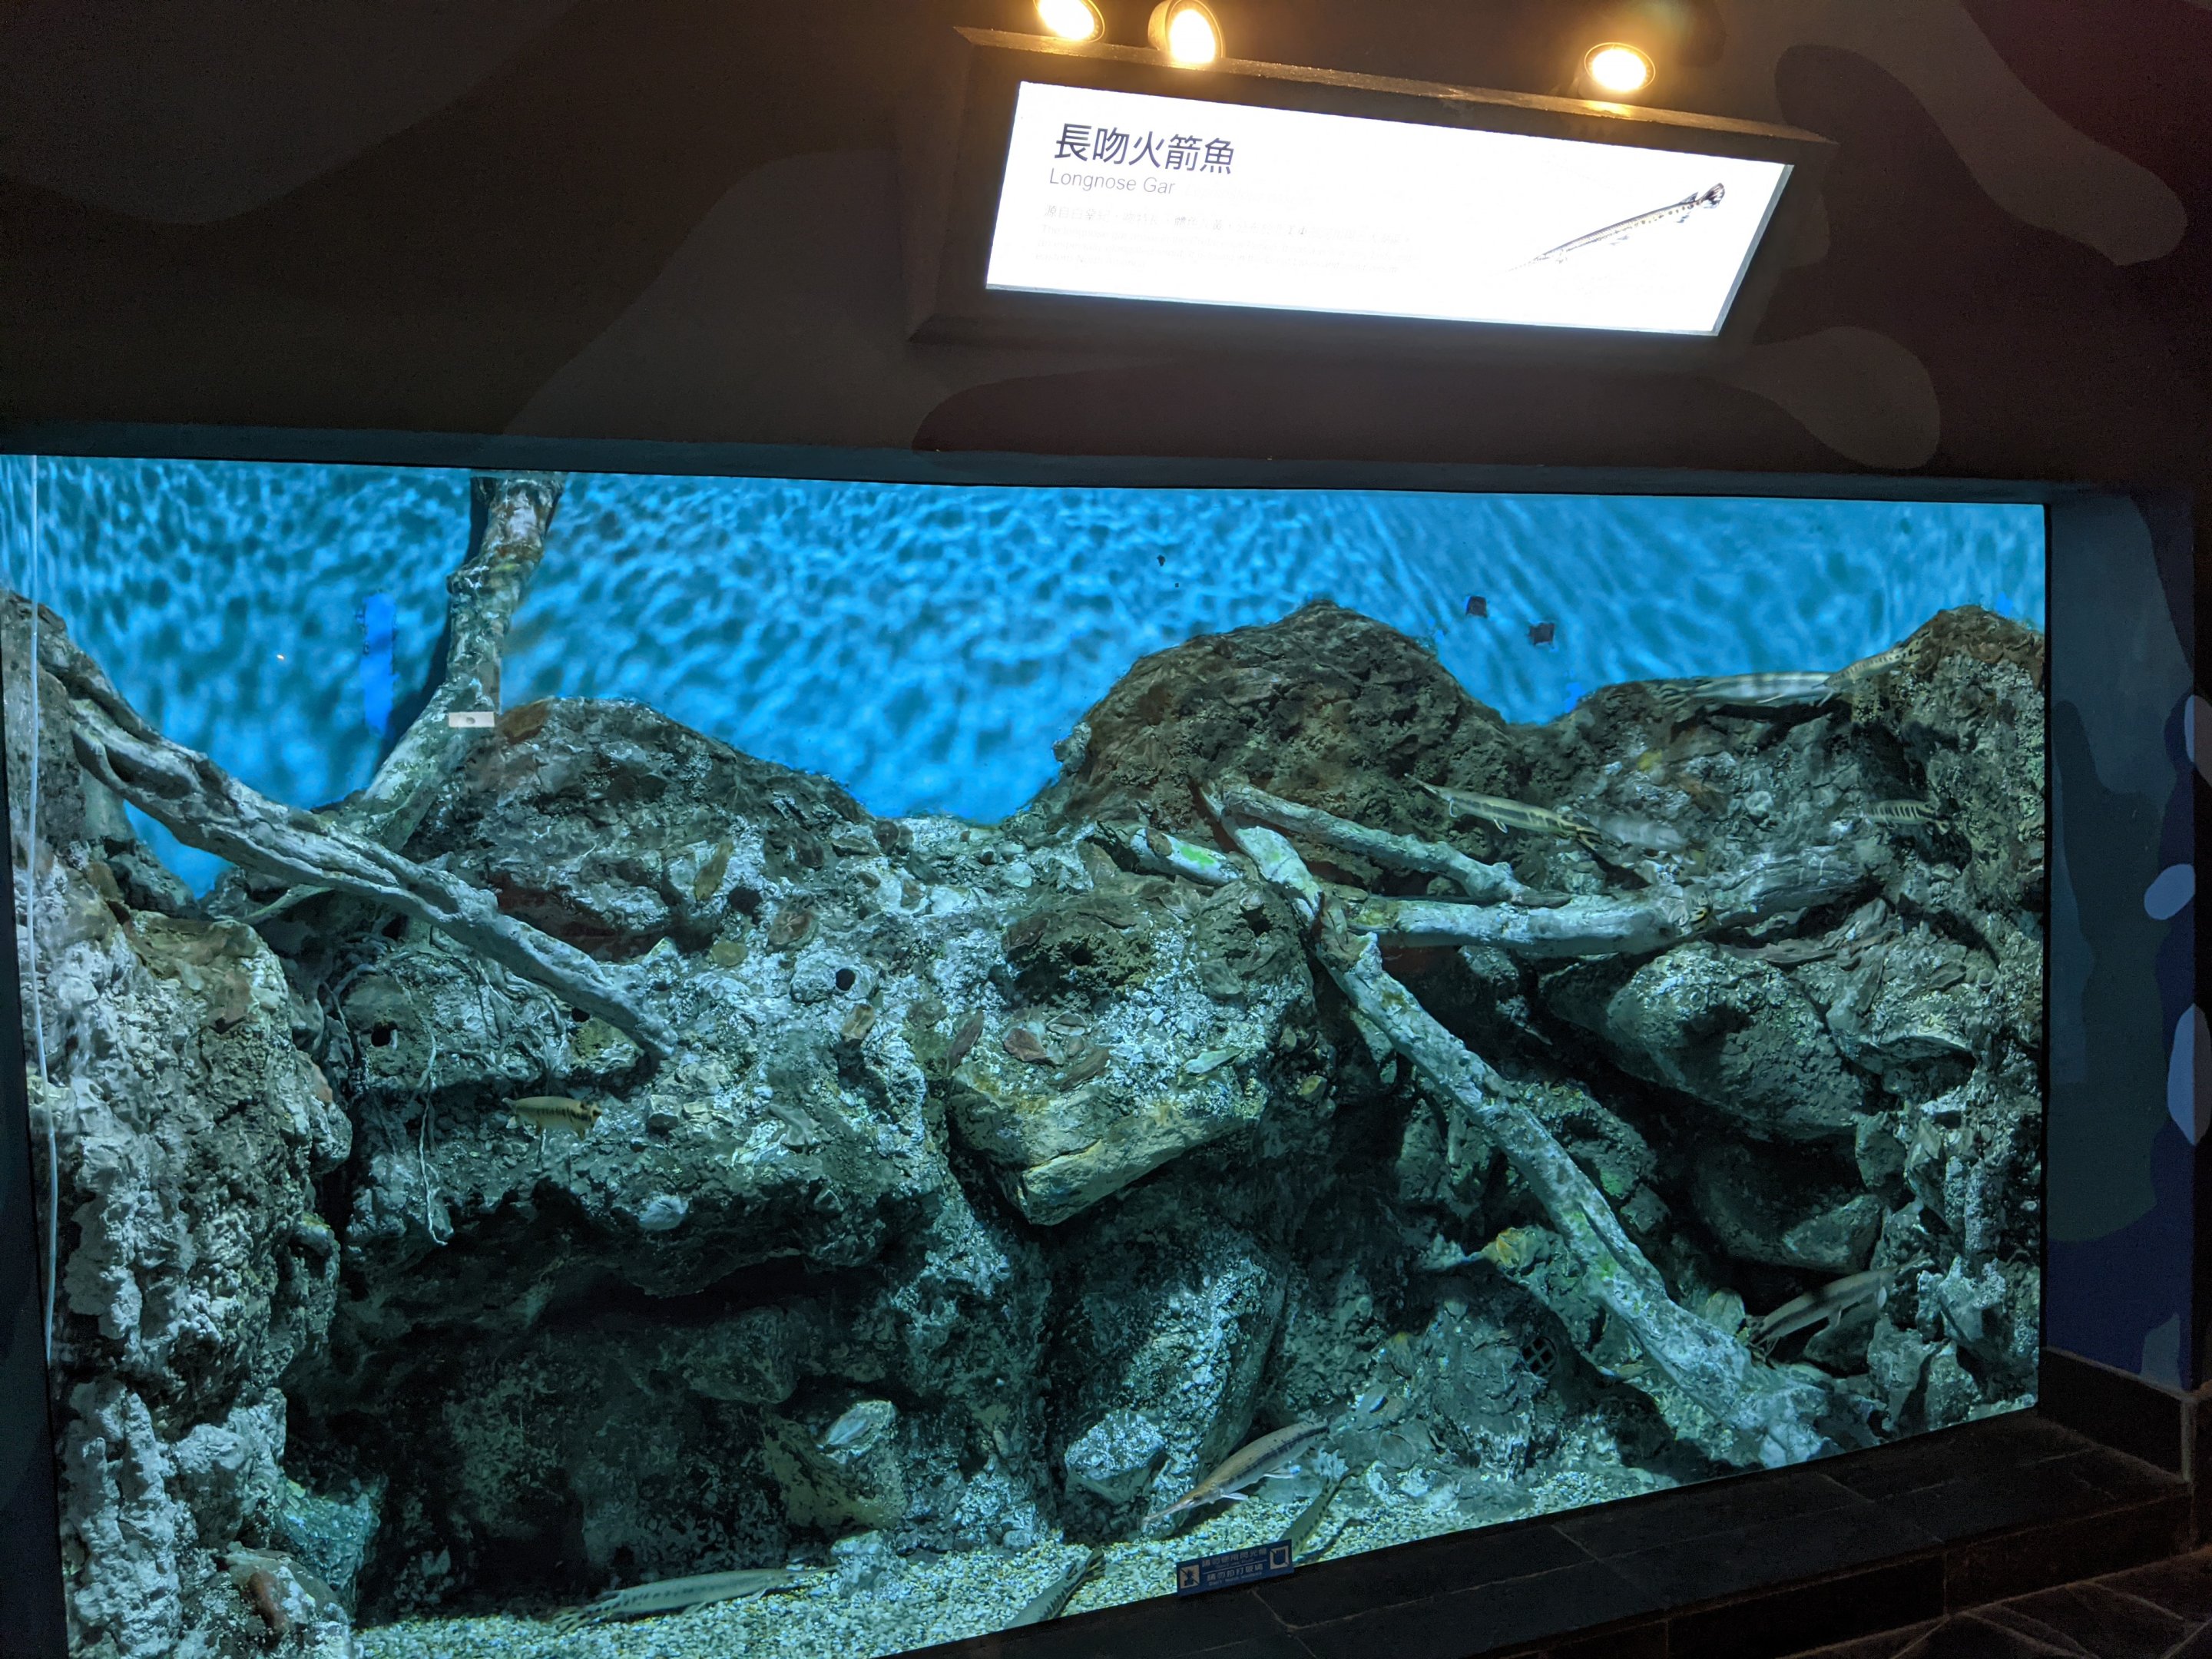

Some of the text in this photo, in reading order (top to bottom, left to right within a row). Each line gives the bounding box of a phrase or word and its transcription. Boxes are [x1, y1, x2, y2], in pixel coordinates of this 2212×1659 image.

[1054, 123, 1234, 174] 長吻火箭魚
[1049, 167, 1176, 194] Longnose Gar
